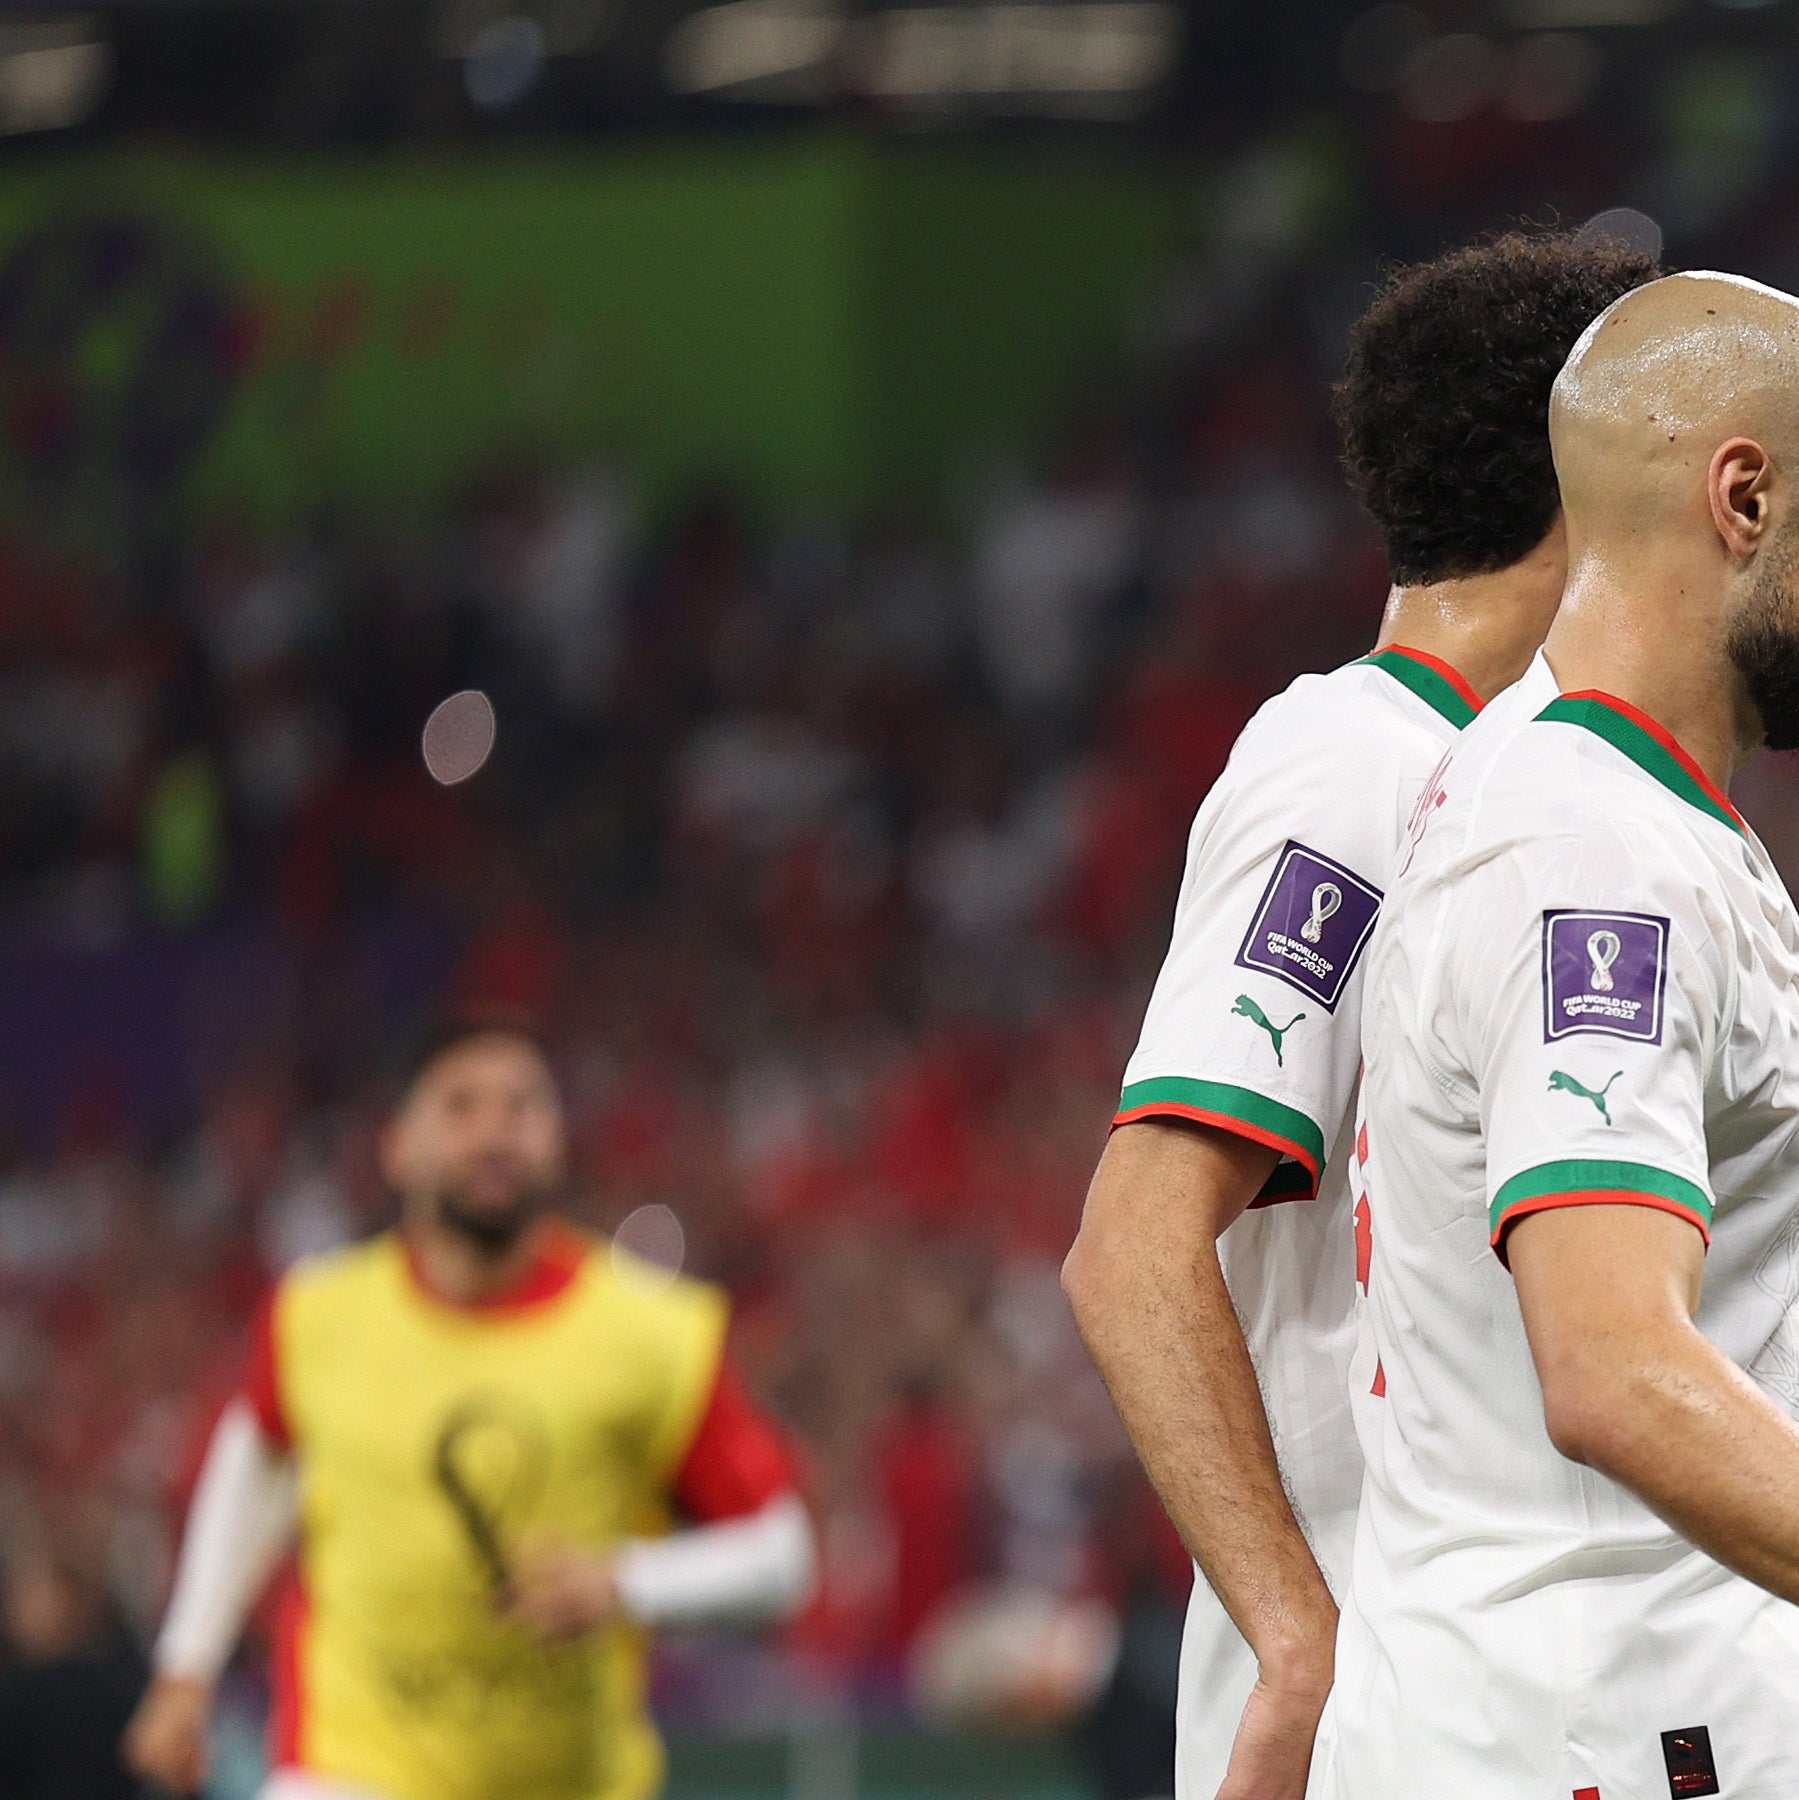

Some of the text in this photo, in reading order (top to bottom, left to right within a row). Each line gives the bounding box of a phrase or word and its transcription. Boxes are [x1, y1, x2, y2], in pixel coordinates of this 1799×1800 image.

[1267, 931, 1334, 972] FIFA WORLD CUP
[1562, 994, 1642, 1011] FIFA WORLD CUP
